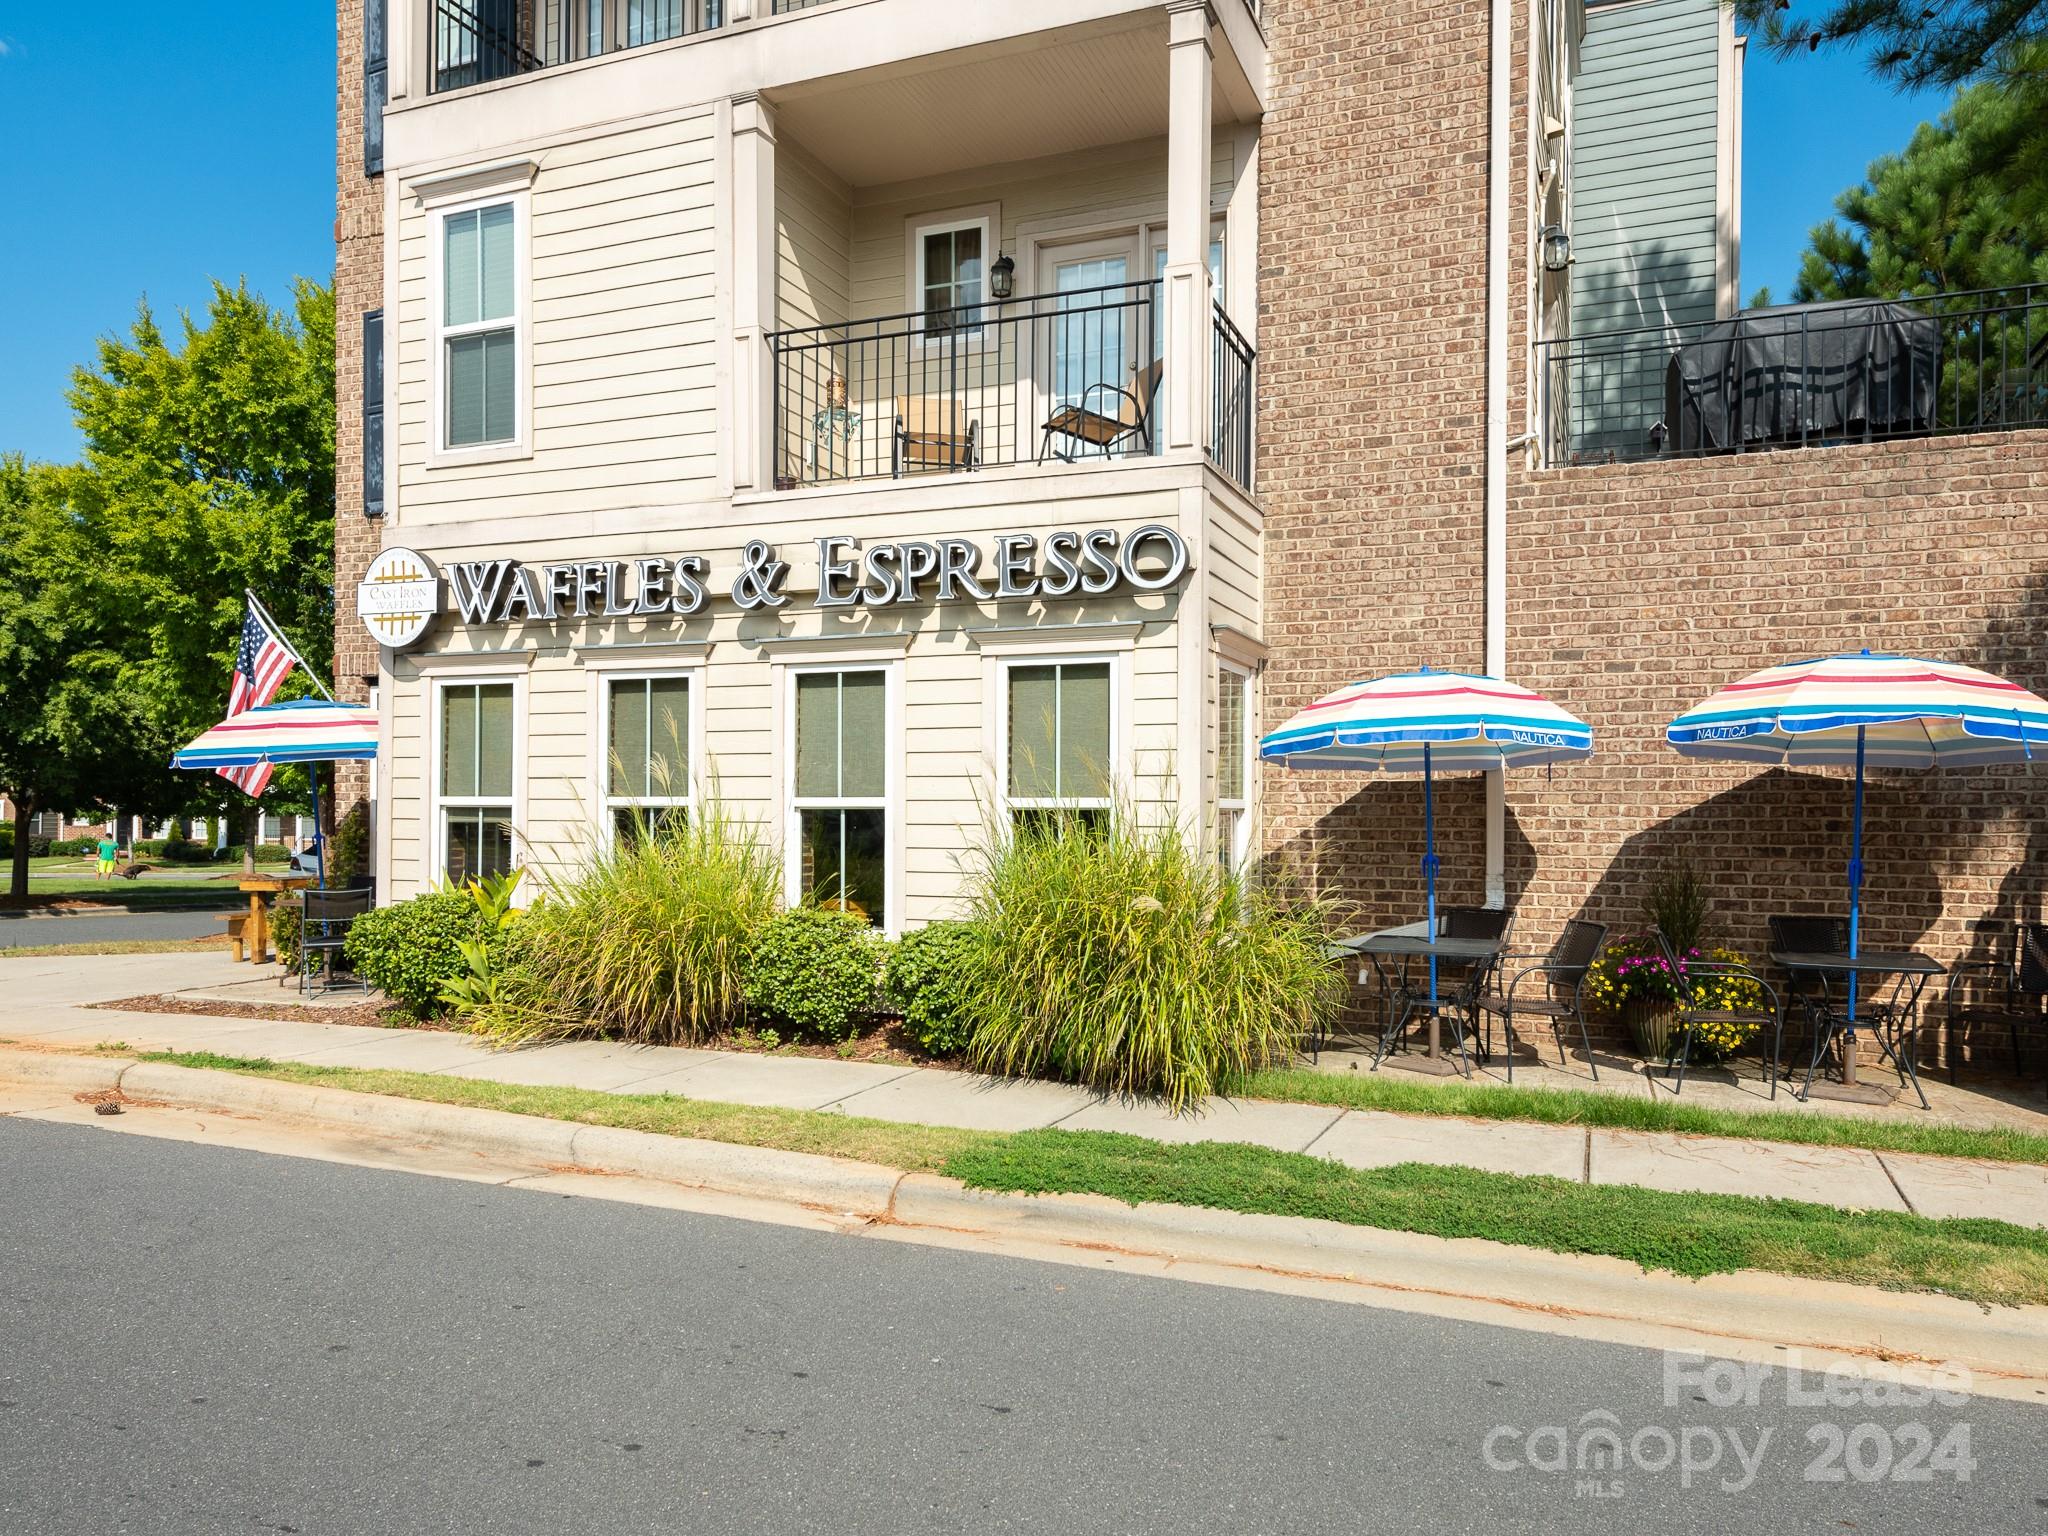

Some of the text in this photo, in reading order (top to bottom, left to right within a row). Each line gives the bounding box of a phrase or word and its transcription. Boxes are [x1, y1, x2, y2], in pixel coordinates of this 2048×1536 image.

[442, 524, 1189, 625] WAFFLES & ESPRESSO
[376, 599, 423, 610] WAFFLES
[1512, 730, 1566, 746] NAUTICA
[1696, 725, 1747, 740] NAUTICA
